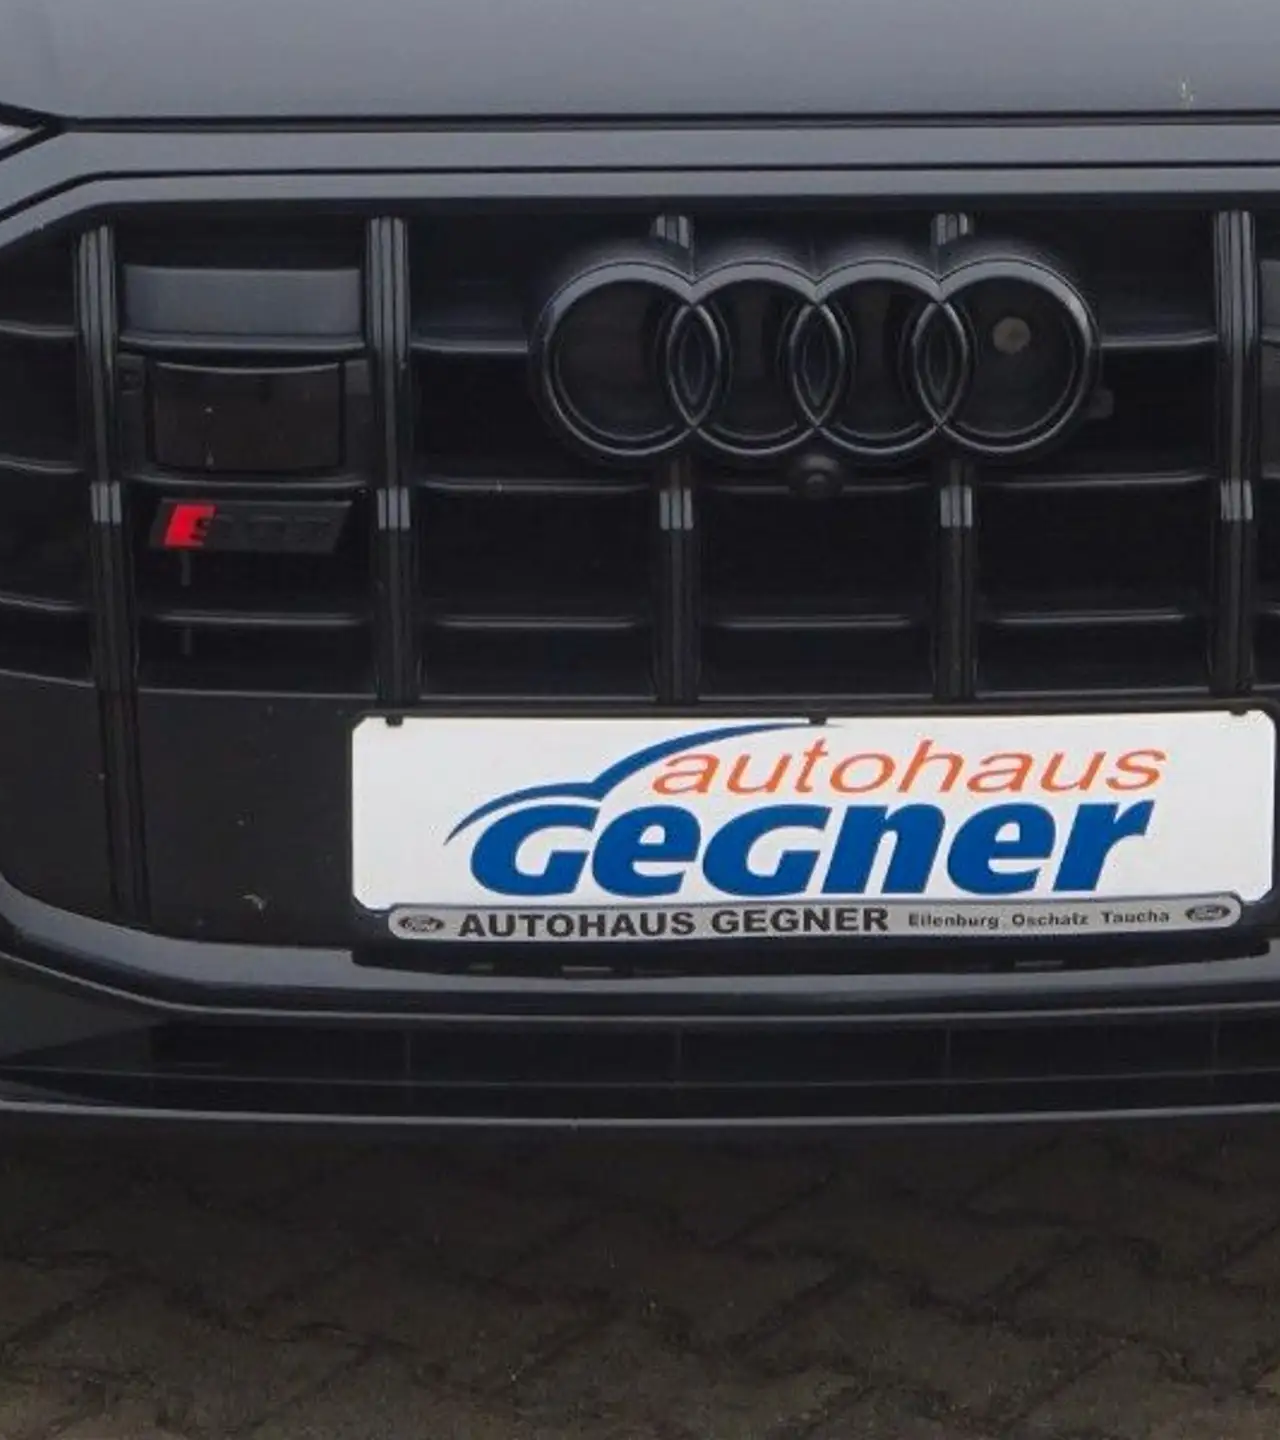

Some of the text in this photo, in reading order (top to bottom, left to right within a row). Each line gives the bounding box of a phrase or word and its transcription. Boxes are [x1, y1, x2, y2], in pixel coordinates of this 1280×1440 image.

[652, 738, 1167, 795] autohaus
[458, 911, 696, 937] AUTOHAUS
[711, 906, 889, 934] GEGNER
[908, 912, 999, 929] Eilenburg
[1011, 911, 1089, 926] Oschatz
[1101, 909, 1170, 924] Taucha
